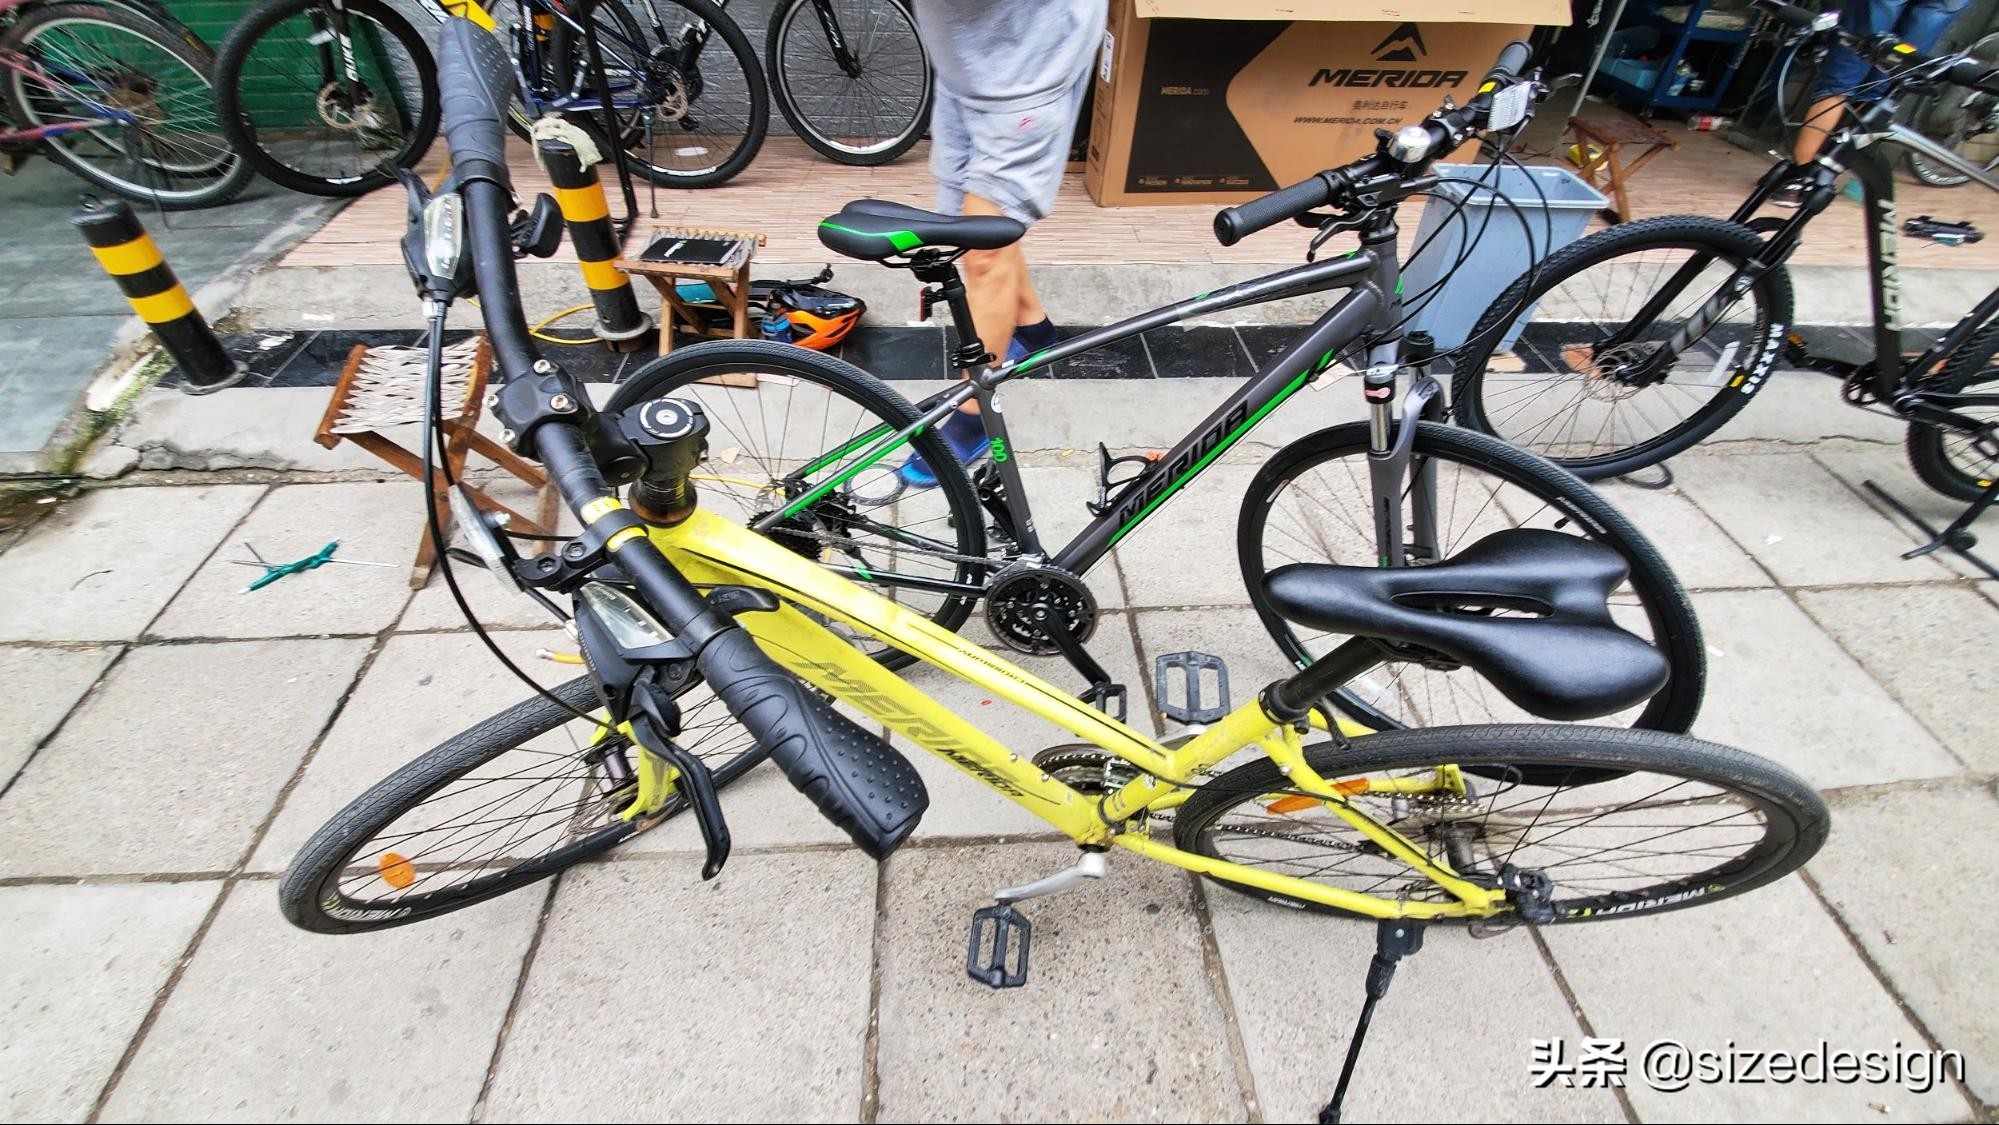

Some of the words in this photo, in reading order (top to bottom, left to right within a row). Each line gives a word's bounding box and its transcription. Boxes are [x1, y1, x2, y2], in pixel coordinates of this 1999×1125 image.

[1308, 69, 1469, 88] MERIDA
[1878, 199, 1902, 332] MERIDA
[1740, 322, 1785, 395] MAXXIS
[1118, 399, 1249, 527] MERIDA
[1596, 887, 1705, 916] MERIDA
